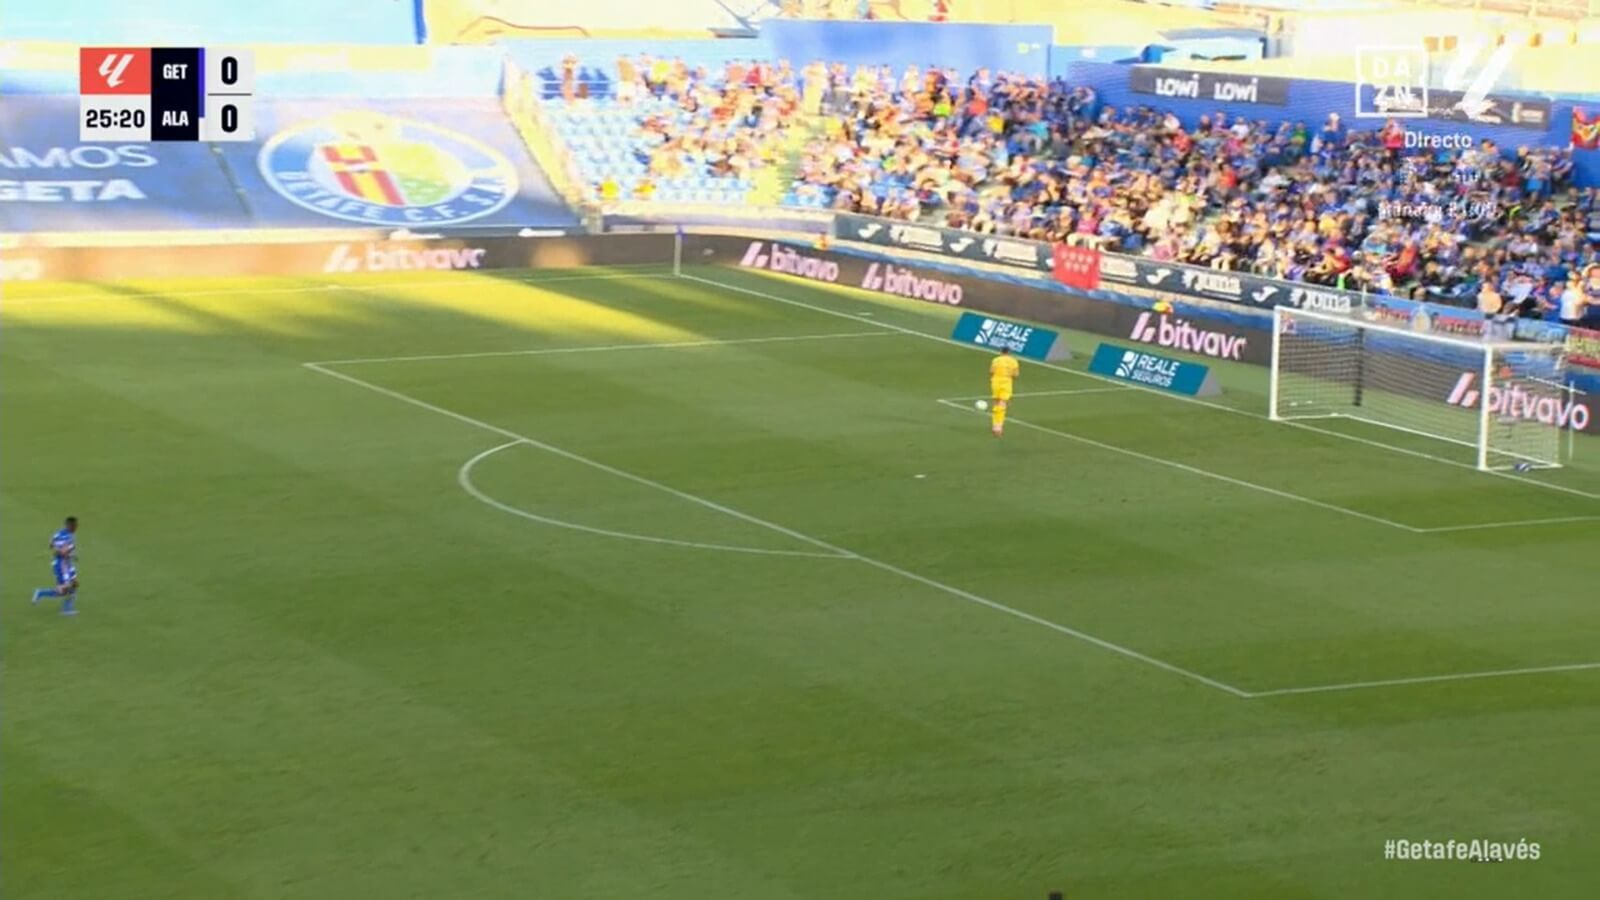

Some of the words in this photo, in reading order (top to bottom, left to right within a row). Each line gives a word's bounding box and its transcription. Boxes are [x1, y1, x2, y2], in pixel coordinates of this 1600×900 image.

[770, 244, 839, 282] bitvavo
[884, 265, 963, 305] bitvavo
[995, 319, 1033, 342] REALE
[1136, 354, 1181, 378] REALE
